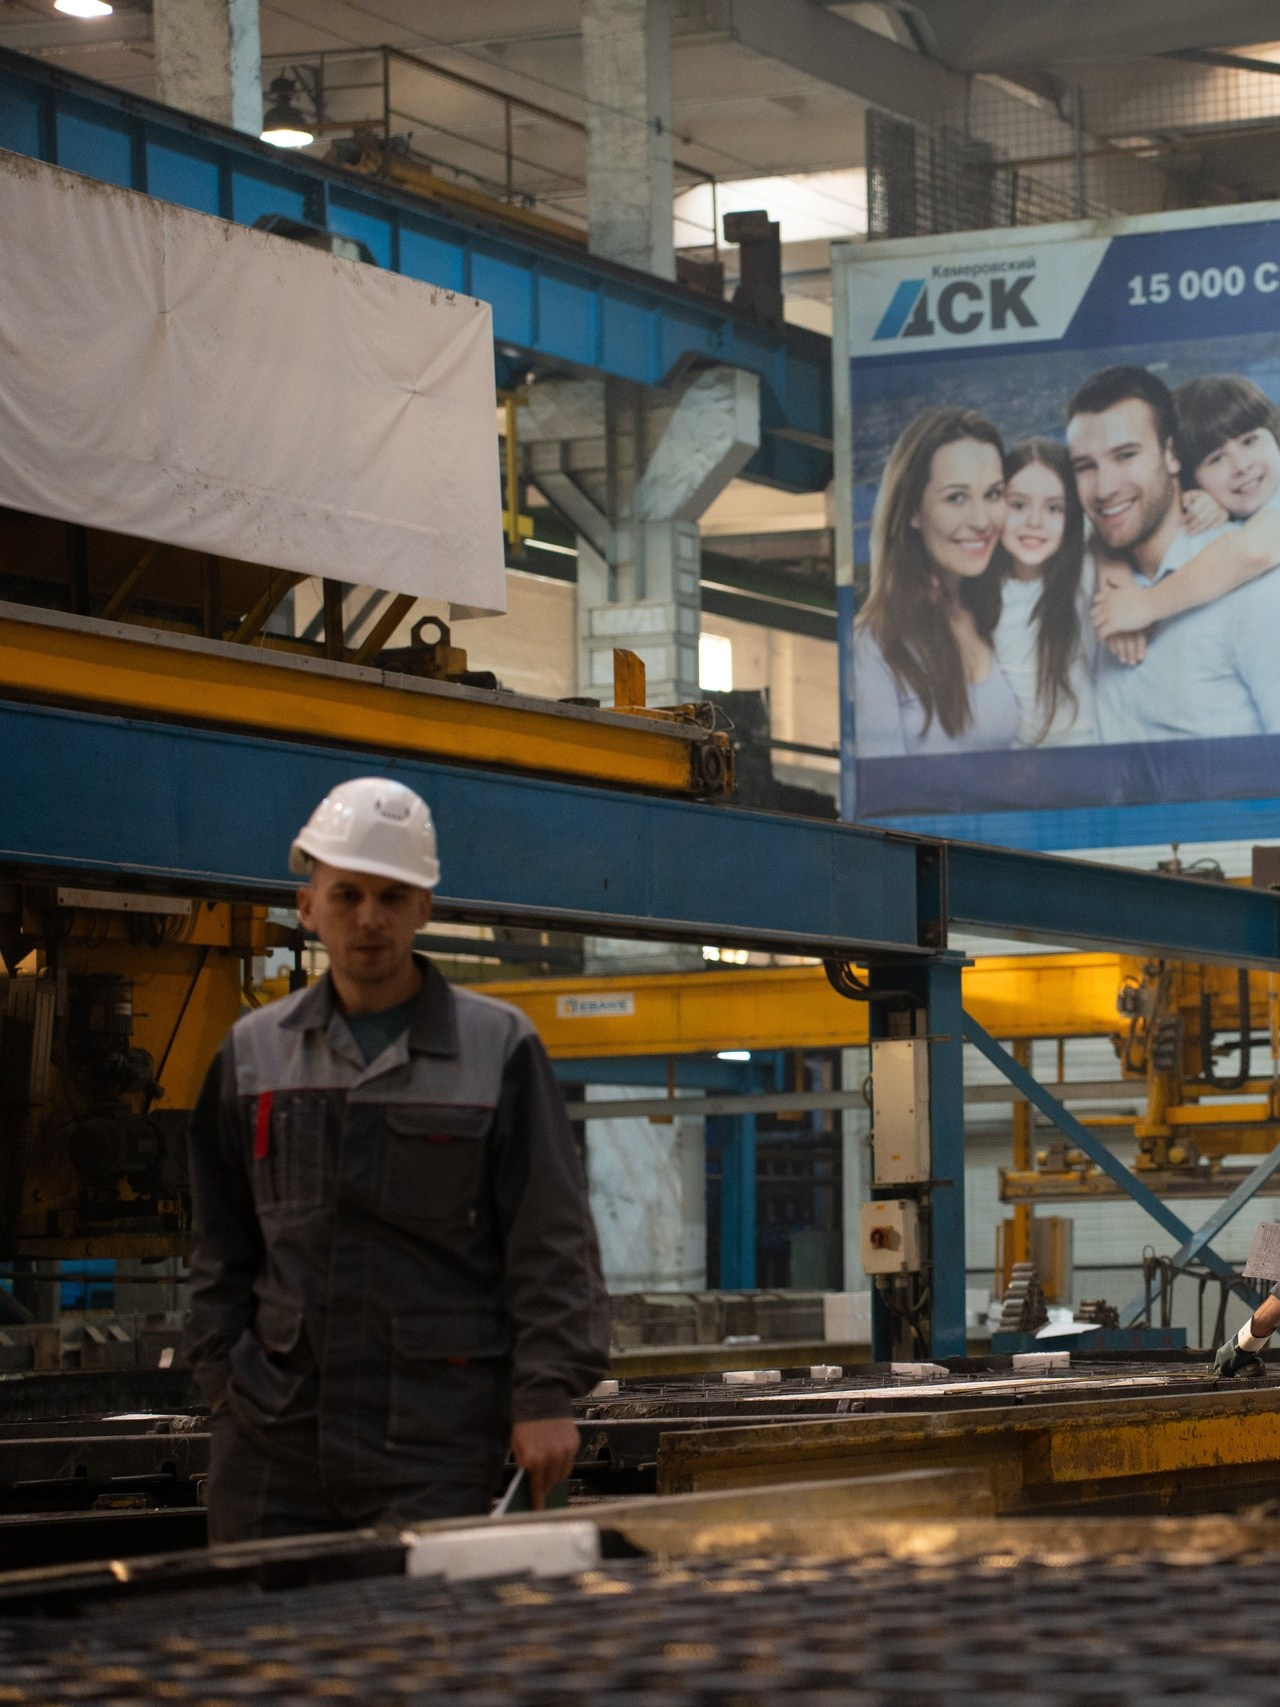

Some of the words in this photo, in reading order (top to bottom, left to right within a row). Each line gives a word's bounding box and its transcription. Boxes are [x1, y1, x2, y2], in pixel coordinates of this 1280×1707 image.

[932, 257, 1036, 278] Кемеровский
[1128, 273, 1171, 305] 15
[1178, 265, 1246, 301] 000
[872, 274, 1039, 341] ДСК
